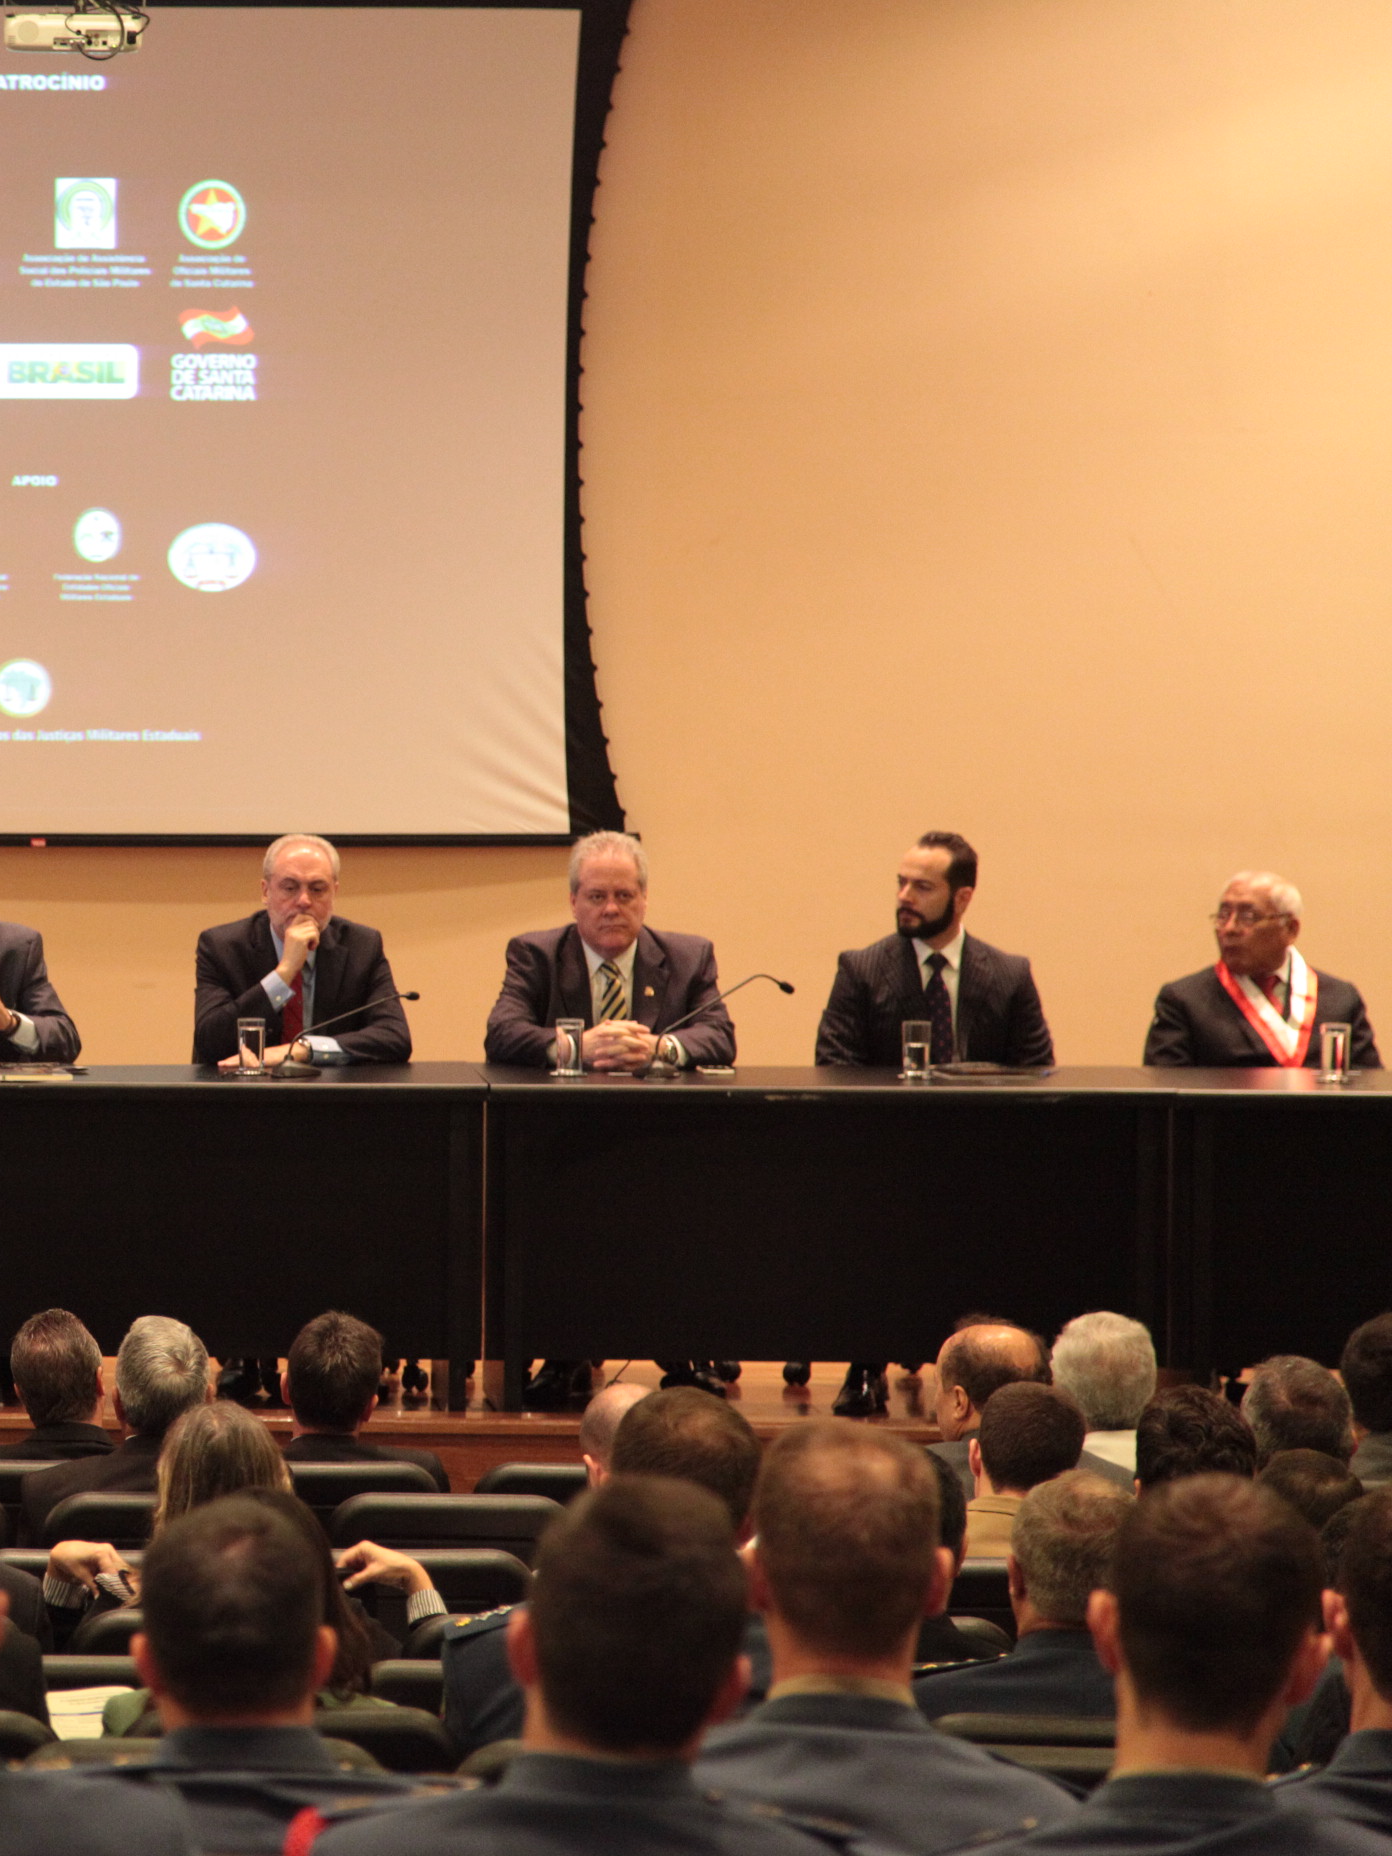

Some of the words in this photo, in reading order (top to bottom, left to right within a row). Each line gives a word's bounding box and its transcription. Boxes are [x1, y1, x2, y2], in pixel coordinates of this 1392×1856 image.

[170, 353, 258, 369] GOVERNO
[7, 361, 127, 384] BRASIL
[171, 369, 196, 385] DE
[197, 369, 257, 385] SANTA
[169, 385, 258, 401] CATARINA
[11, 474, 60, 487] APOIO
[86, 729, 141, 741] Militares
[142, 729, 203, 741] Estaduais
